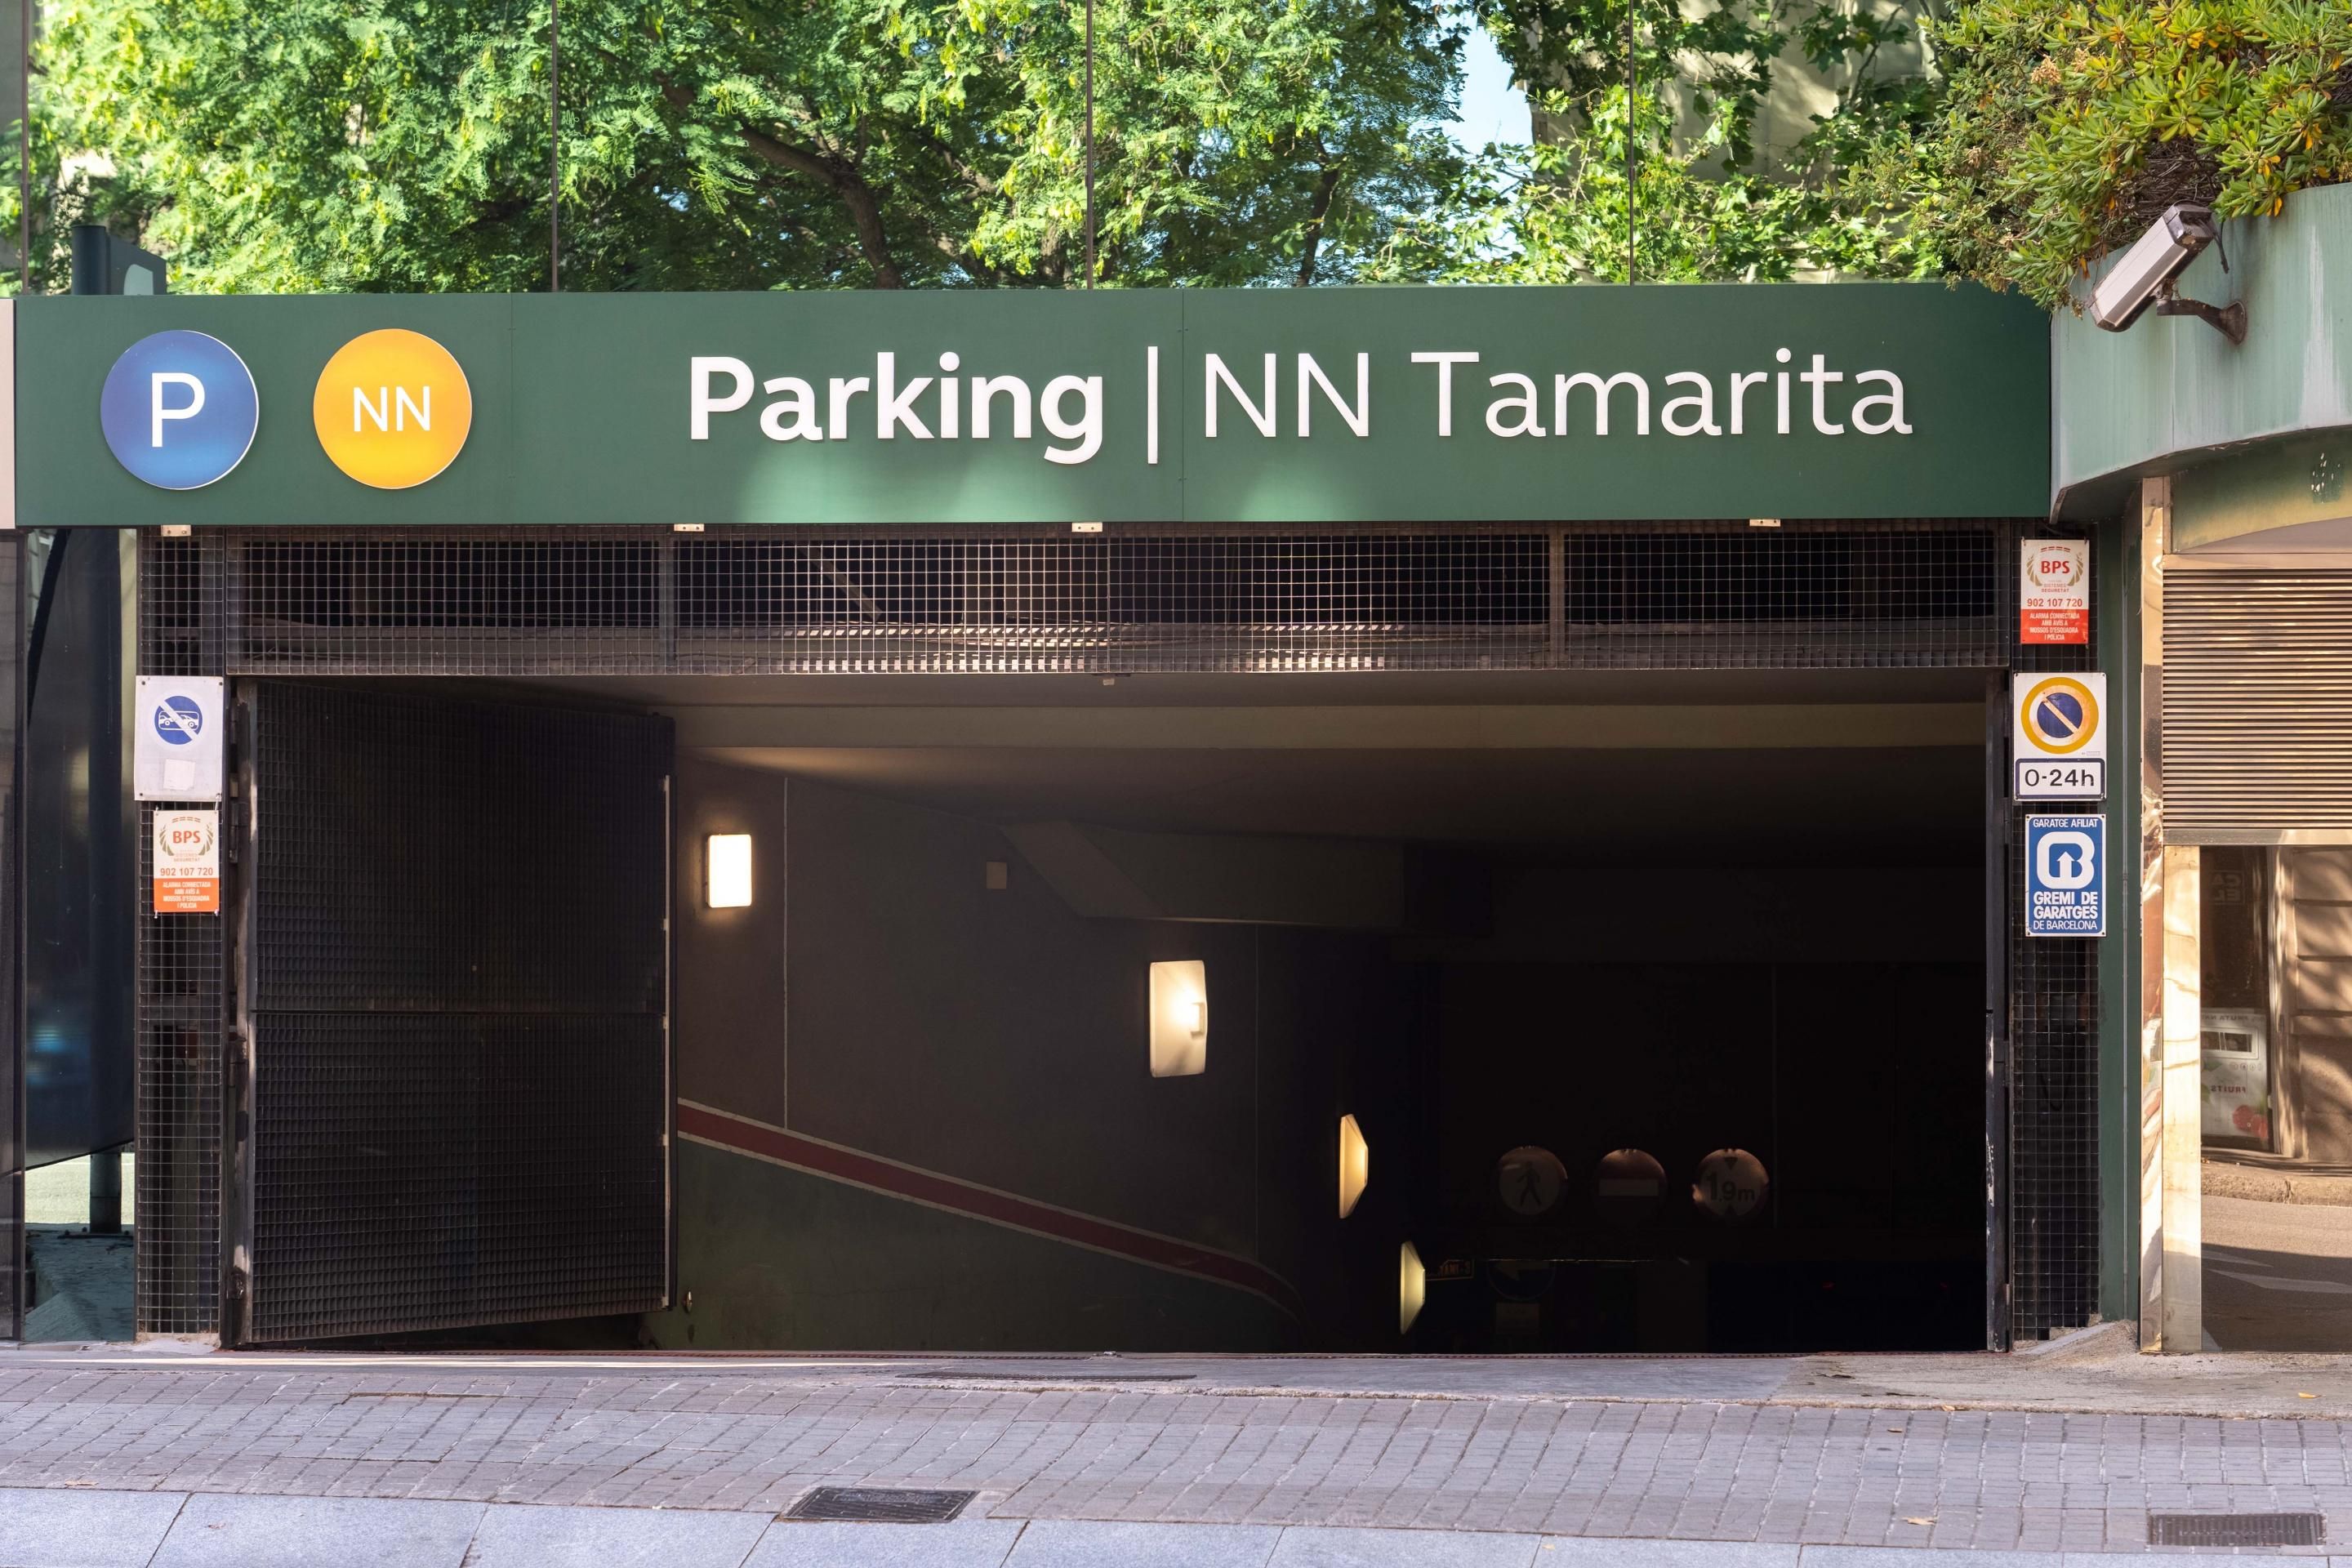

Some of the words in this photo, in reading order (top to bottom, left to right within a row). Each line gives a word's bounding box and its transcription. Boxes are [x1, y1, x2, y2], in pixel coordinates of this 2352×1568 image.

[150, 372, 206, 448] P
[353, 385, 431, 432] NN
[690, 351, 1104, 465] Parking
[1205, 353, 1369, 438] NN
[1410, 347, 1913, 438] Tamarita
[2041, 560, 2070, 574] BPS
[2027, 598, 2044, 608] 902
[2047, 598, 2063, 608] 107
[2066, 598, 2082, 608] 720
[2025, 768, 2095, 787] 0-24h
[2033, 818, 2069, 828] GARATGE
[2070, 818, 2099, 828] AFILIAT
[172, 831, 201, 844] BPS
[160, 867, 176, 876] 902
[179, 867, 195, 876] 107
[197, 867, 213, 876] 720
[2033, 890, 2075, 906] GREMI
[2081, 891, 2098, 905] DE
[2033, 905, 2099, 920] GARATGES
[2033, 920, 2045, 930] DE
[2046, 920, 2098, 930] BARCELONA
